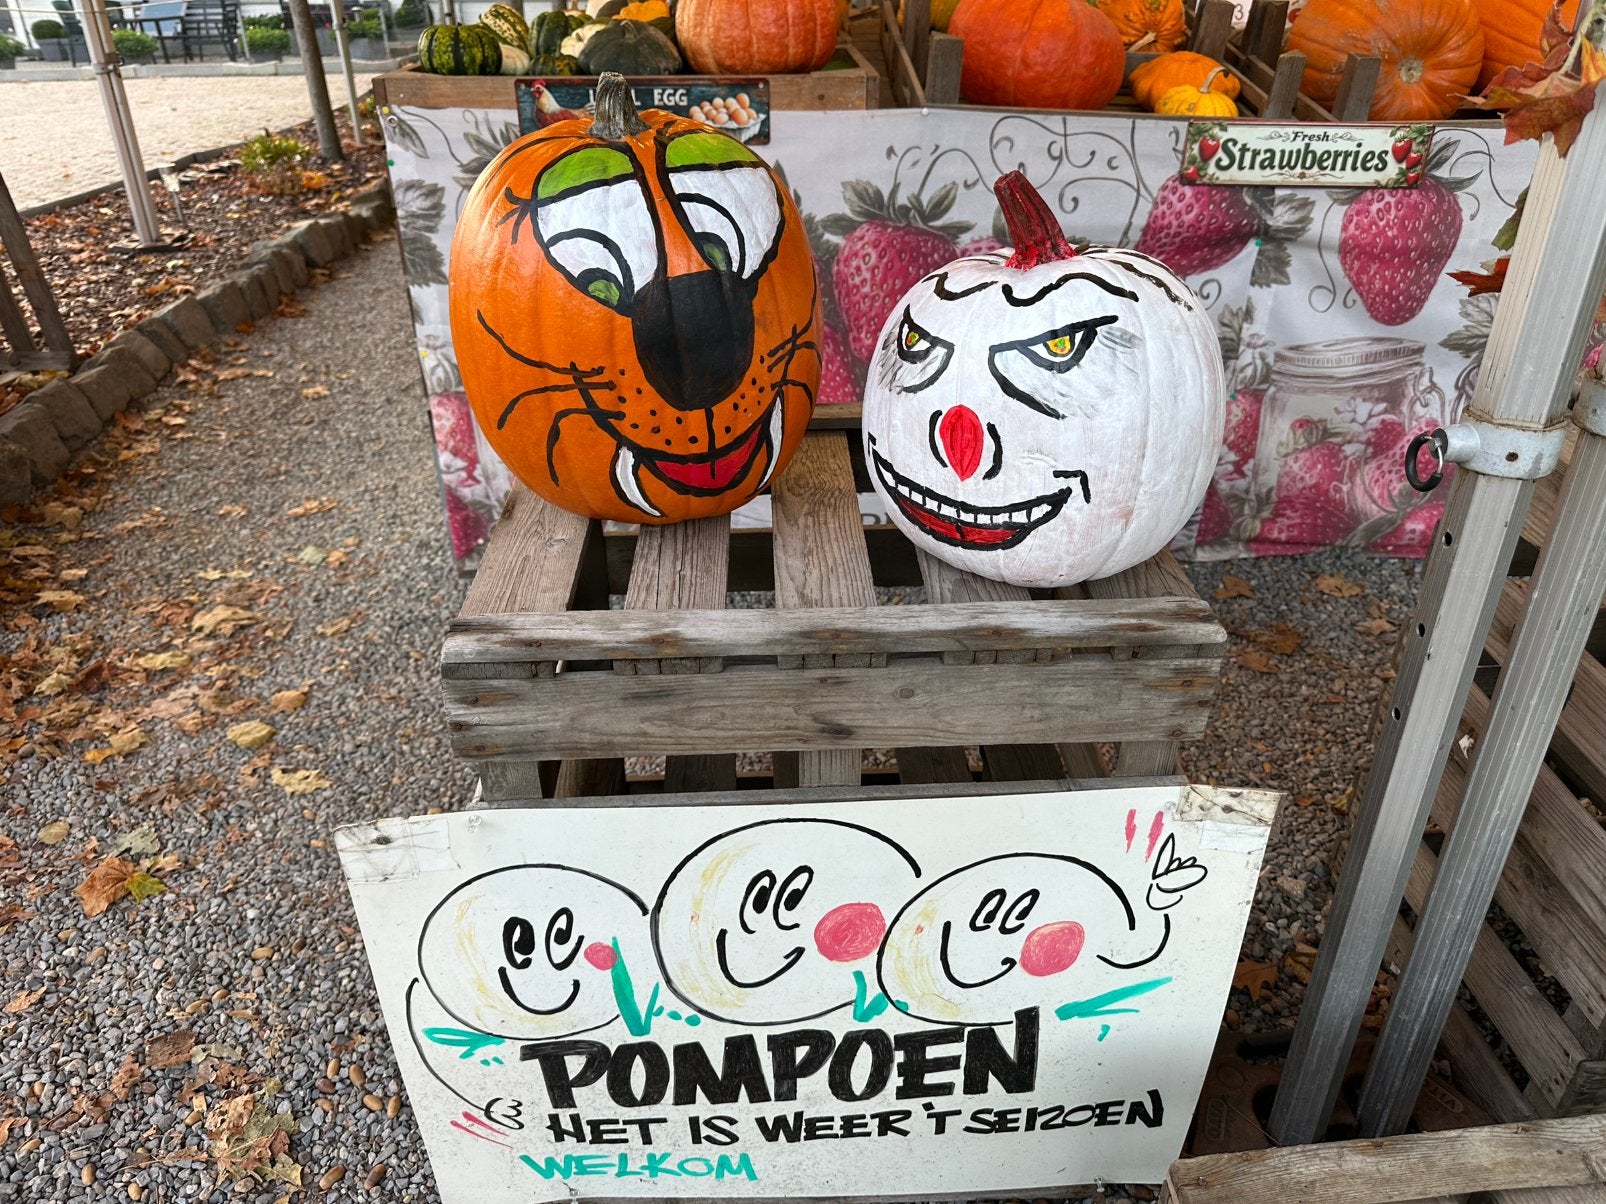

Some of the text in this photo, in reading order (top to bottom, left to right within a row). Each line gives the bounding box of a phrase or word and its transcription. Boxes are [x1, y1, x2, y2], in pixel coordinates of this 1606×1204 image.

[653, 88, 688, 106] EGG
[1291, 130, 1330, 142] Fresh
[1214, 138, 1389, 172] Strawberries
[520, 1006, 1040, 1109] POMPOEN
[546, 1112, 668, 1145] HET
[688, 1115, 740, 1146] IS
[755, 1109, 912, 1143] WEER
[962, 1089, 1164, 1134] SEIZOEN
[518, 1152, 759, 1181] WELKOM
